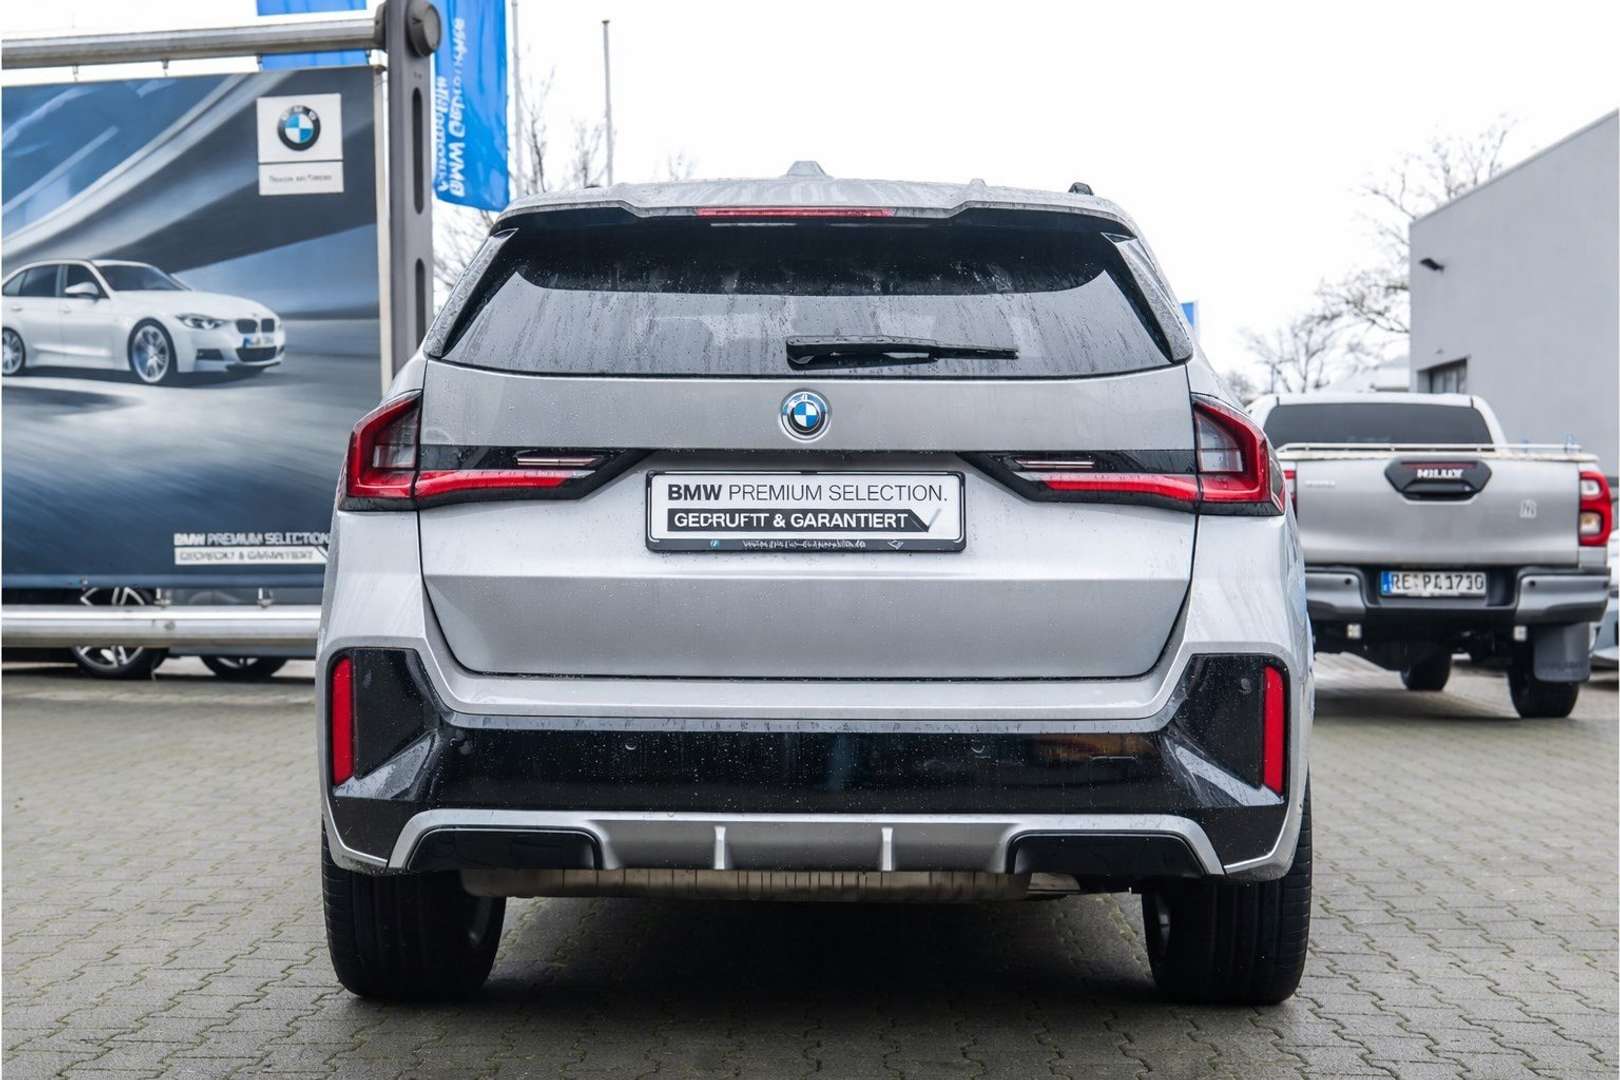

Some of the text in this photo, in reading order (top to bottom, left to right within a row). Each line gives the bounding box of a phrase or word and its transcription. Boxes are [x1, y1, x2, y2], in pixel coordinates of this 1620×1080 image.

[667, 484, 948, 501] BMW PREMIUM SELECTION.
[773, 512, 785, 528] &
[790, 512, 908, 528] GARANTIERT
[174, 533, 206, 546] BMW
[207, 533, 264, 545] PREMIUM
